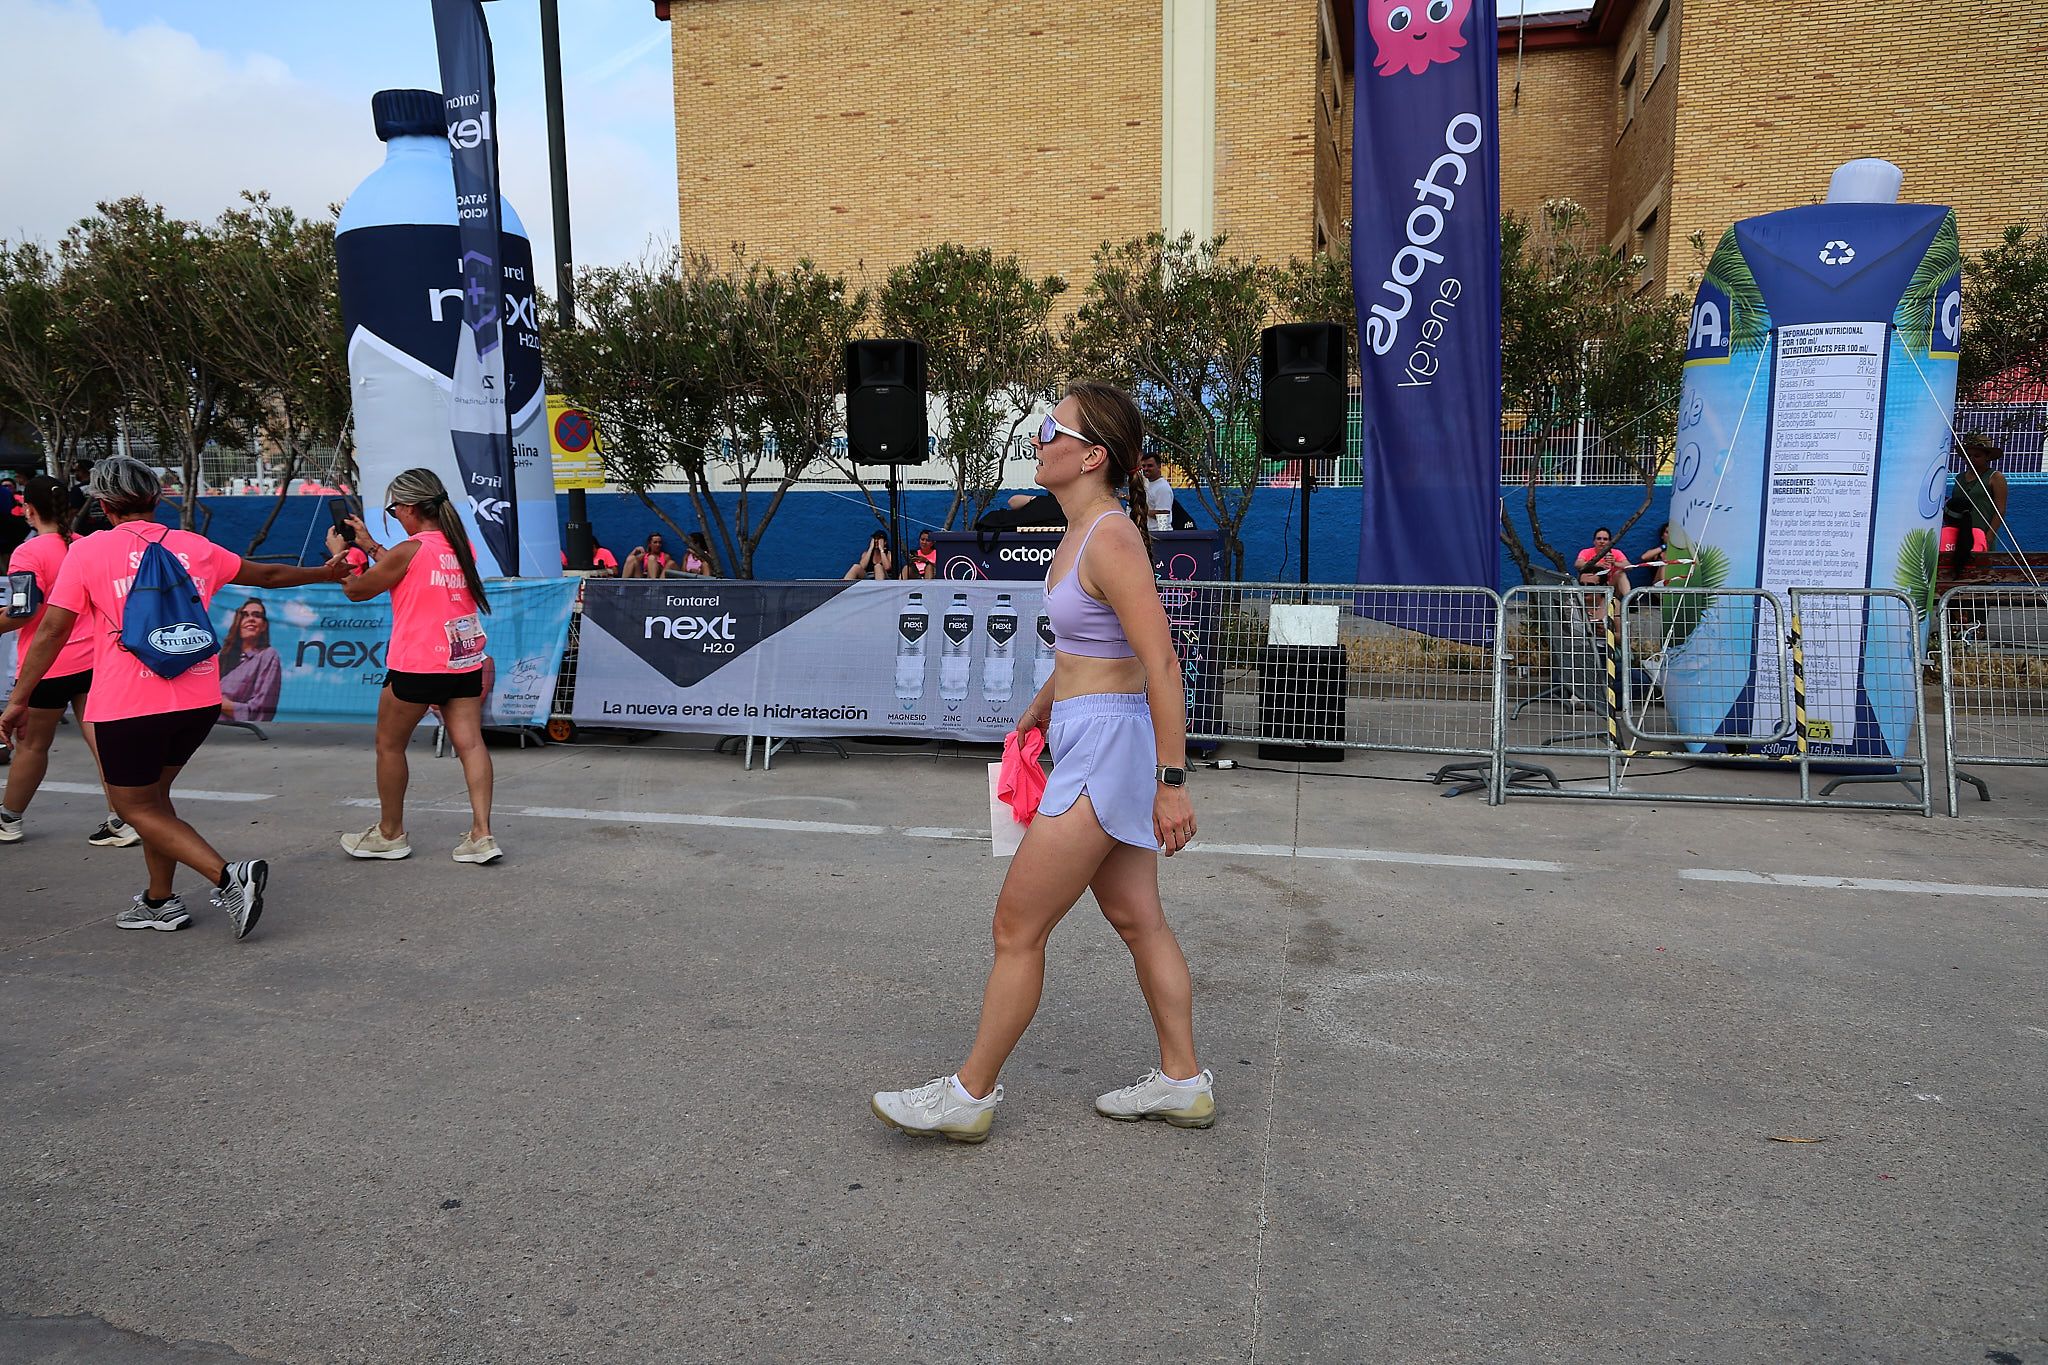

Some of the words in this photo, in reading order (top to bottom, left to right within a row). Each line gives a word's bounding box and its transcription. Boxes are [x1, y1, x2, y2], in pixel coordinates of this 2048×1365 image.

[1783, 328, 1823, 338] INFORMACION
[1825, 327, 1863, 335] NUTRICIONAL
[1782, 346, 1813, 355] NUTRITION
[1000, 546, 1056, 565] octop
[666, 595, 719, 607] Fontarel
[320, 617, 384, 629] Fontarel
[644, 612, 737, 640] next
[904, 621, 923, 629] next
[155, 632, 211, 647] ASTURIANA
[602, 700, 621, 715] La
[625, 703, 677, 716] nueva
[682, 704, 712, 717] era
[717, 703, 740, 717] de
[743, 703, 758, 717] la
[763, 703, 868, 720] hidratación
[1761, 743, 1790, 754] 330ml
